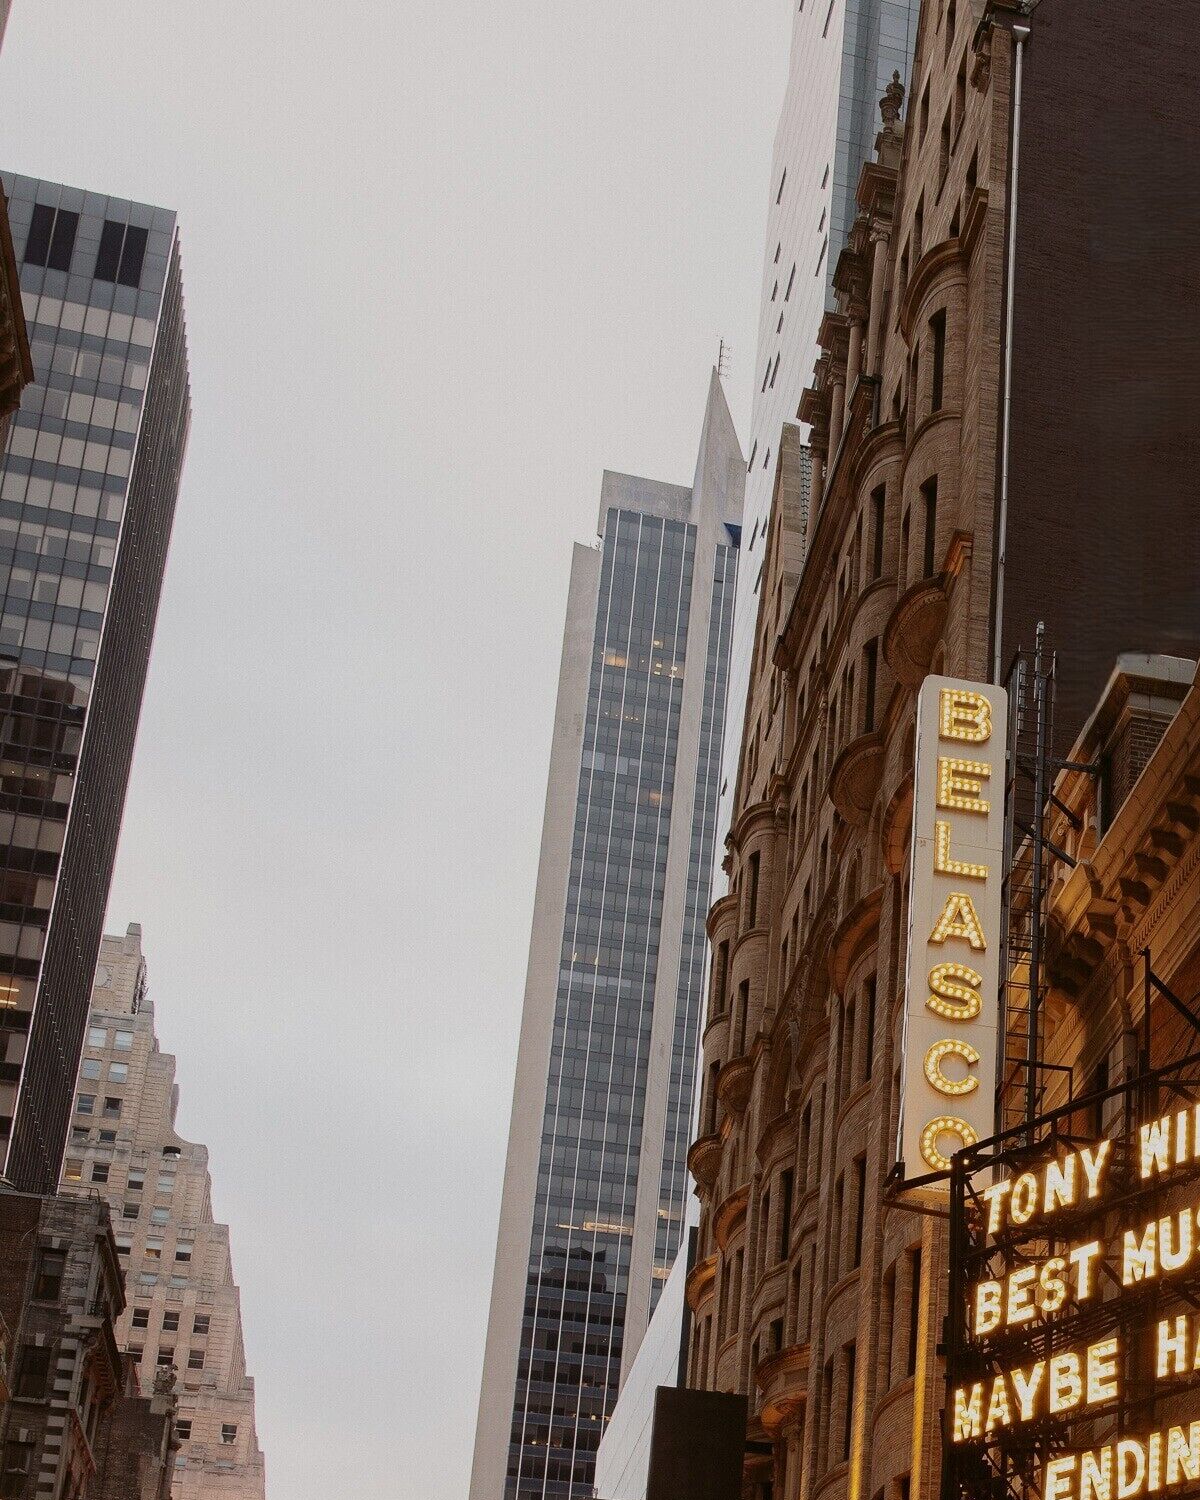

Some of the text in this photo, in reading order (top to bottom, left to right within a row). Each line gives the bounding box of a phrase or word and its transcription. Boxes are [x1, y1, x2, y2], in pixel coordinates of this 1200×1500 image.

[919, 688, 992, 1172] BELASCO
[983, 1140, 1113, 1235] TONY
[975, 1241, 1101, 1335] BEST
[952, 1337, 1119, 1442] MAYBE
